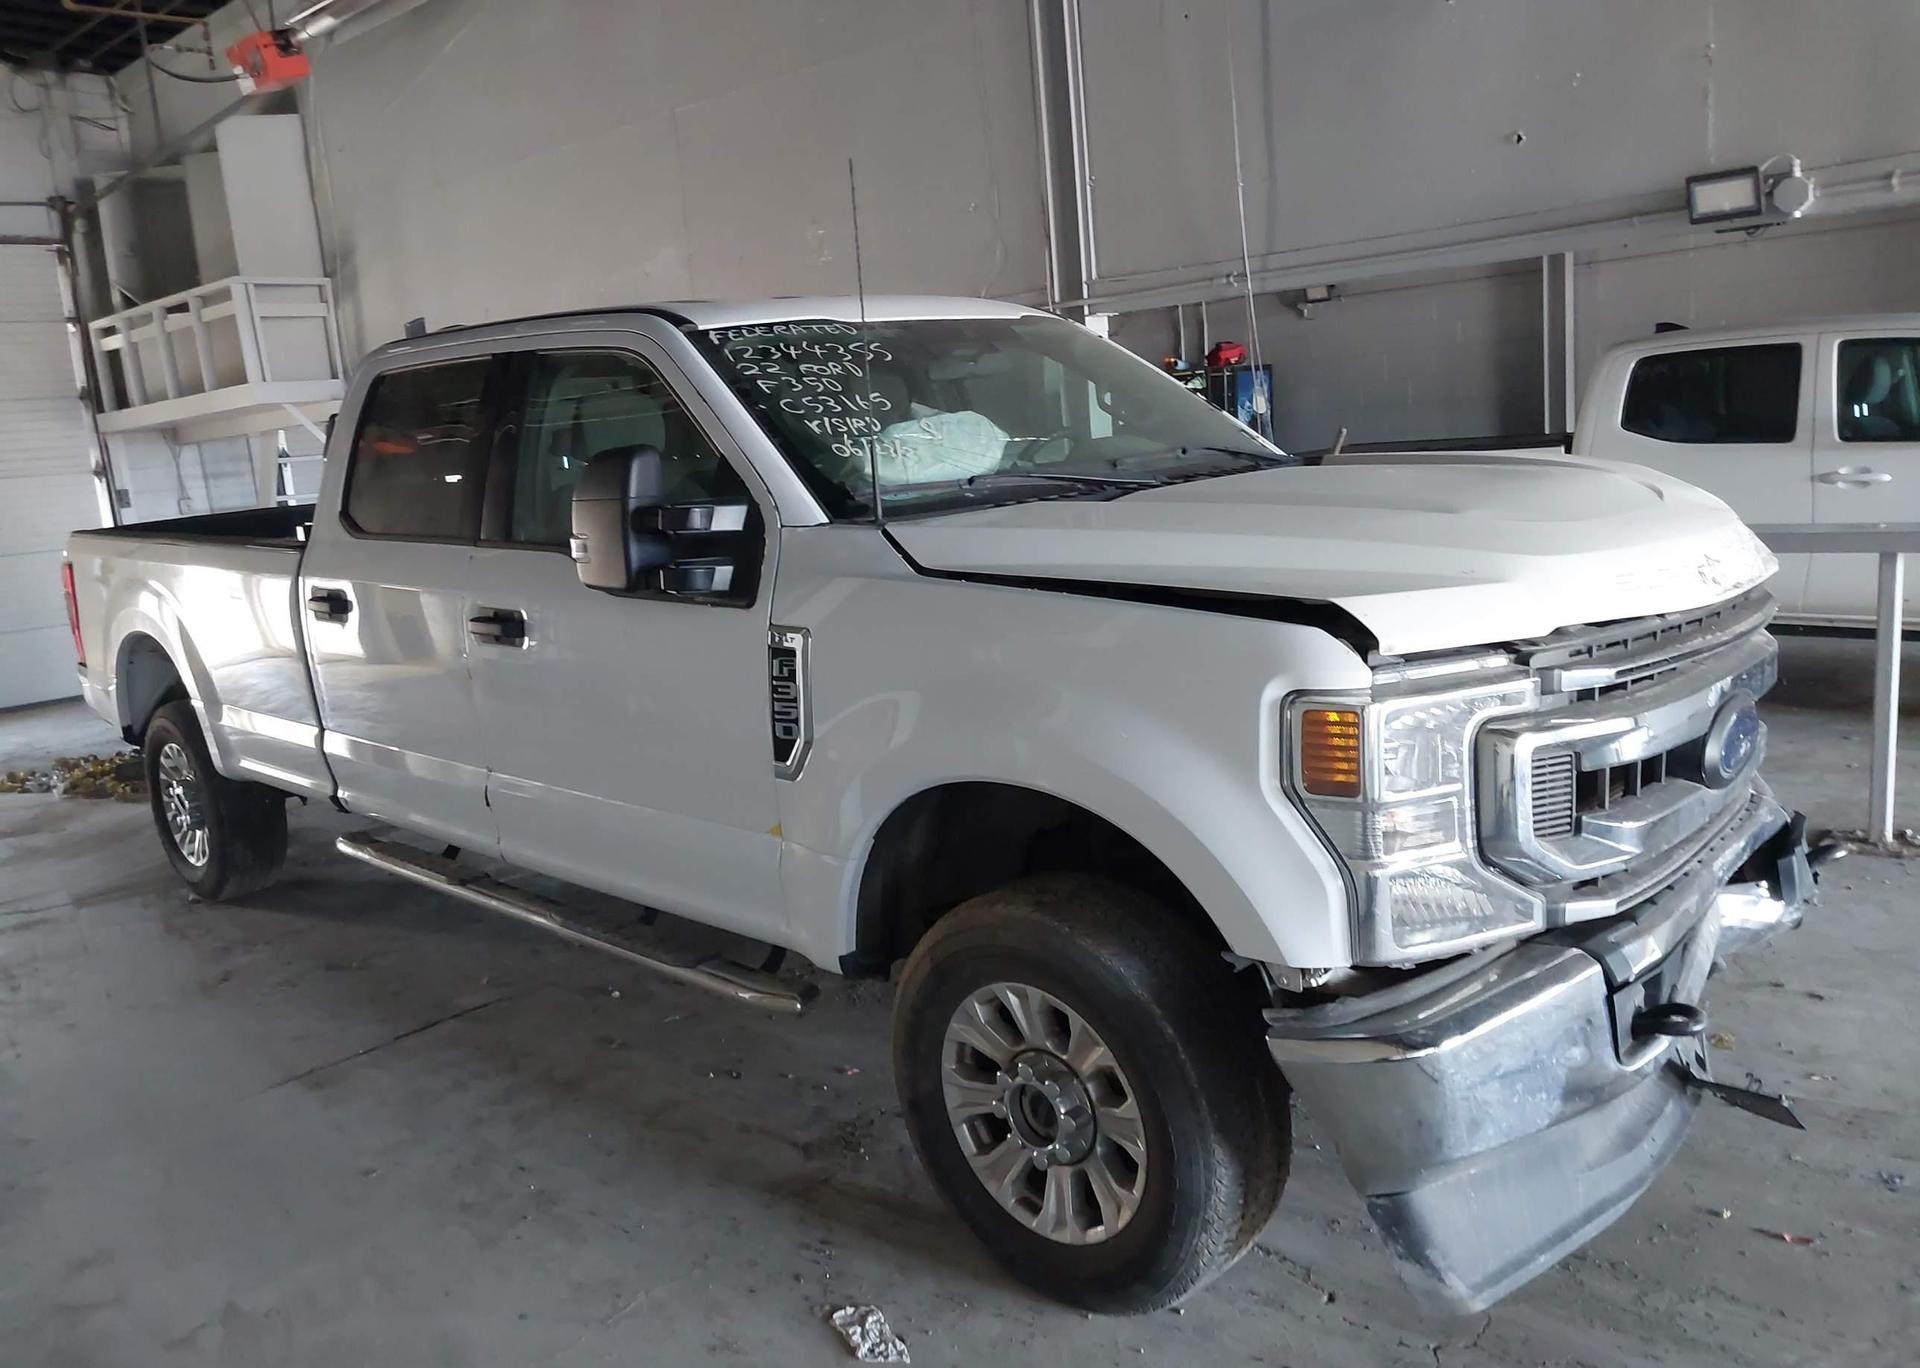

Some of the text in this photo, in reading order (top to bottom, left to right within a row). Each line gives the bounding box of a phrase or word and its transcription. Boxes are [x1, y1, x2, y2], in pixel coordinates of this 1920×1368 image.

[708, 323, 858, 345] FEDERATED
[736, 361, 864, 377] 22 FORD
[756, 376, 843, 394] F350
[779, 392, 892, 414] C53165
[773, 656, 800, 740] F350
